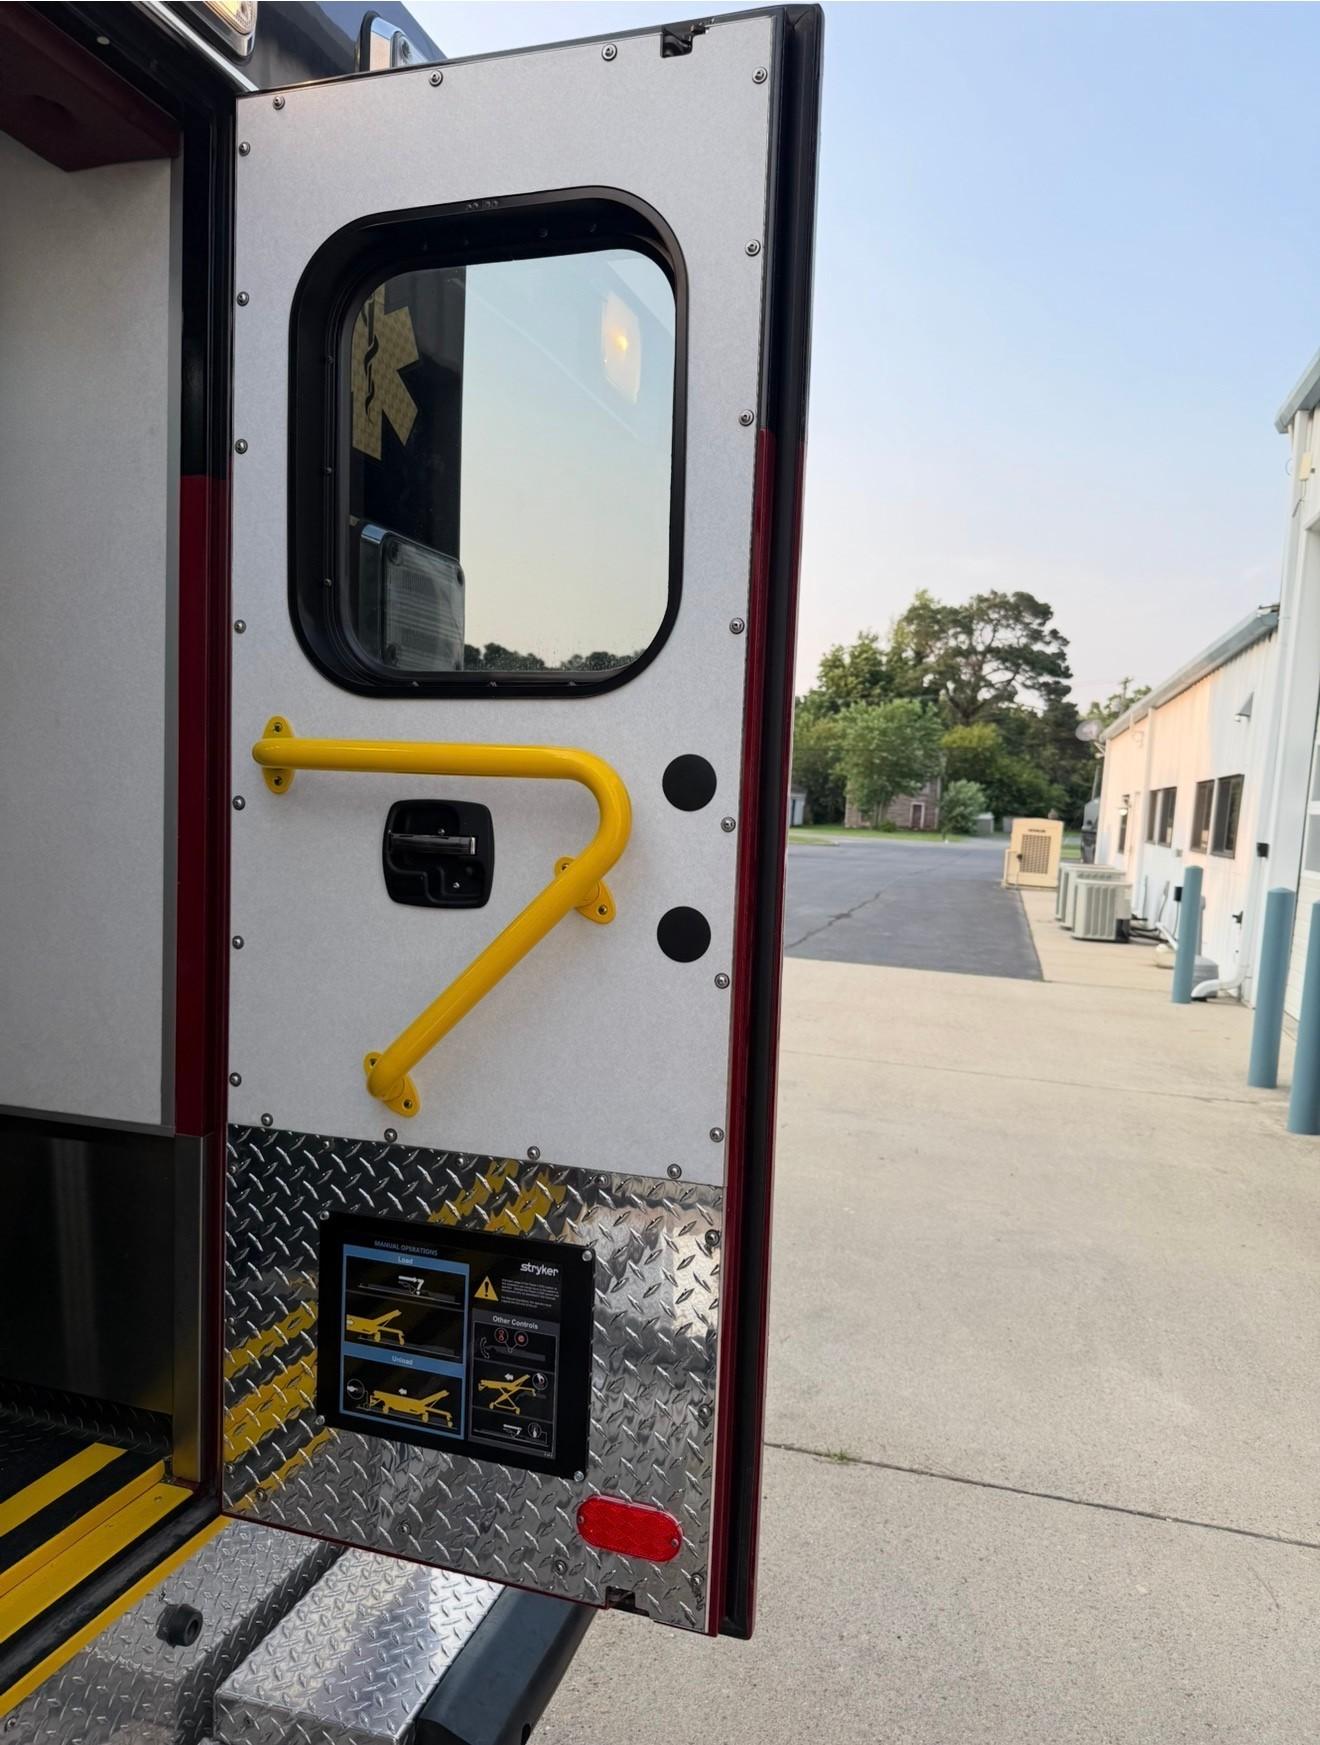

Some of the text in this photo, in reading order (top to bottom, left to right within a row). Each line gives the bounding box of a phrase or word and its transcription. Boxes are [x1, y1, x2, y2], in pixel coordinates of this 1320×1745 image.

[374, 1240, 438, 1256] MANUAL OPERATIONS
[397, 1256, 413, 1264] Load
[520, 1262, 559, 1277] stryker
[492, 1315, 538, 1329] Other Controls
[391, 1355, 413, 1365] Unload
